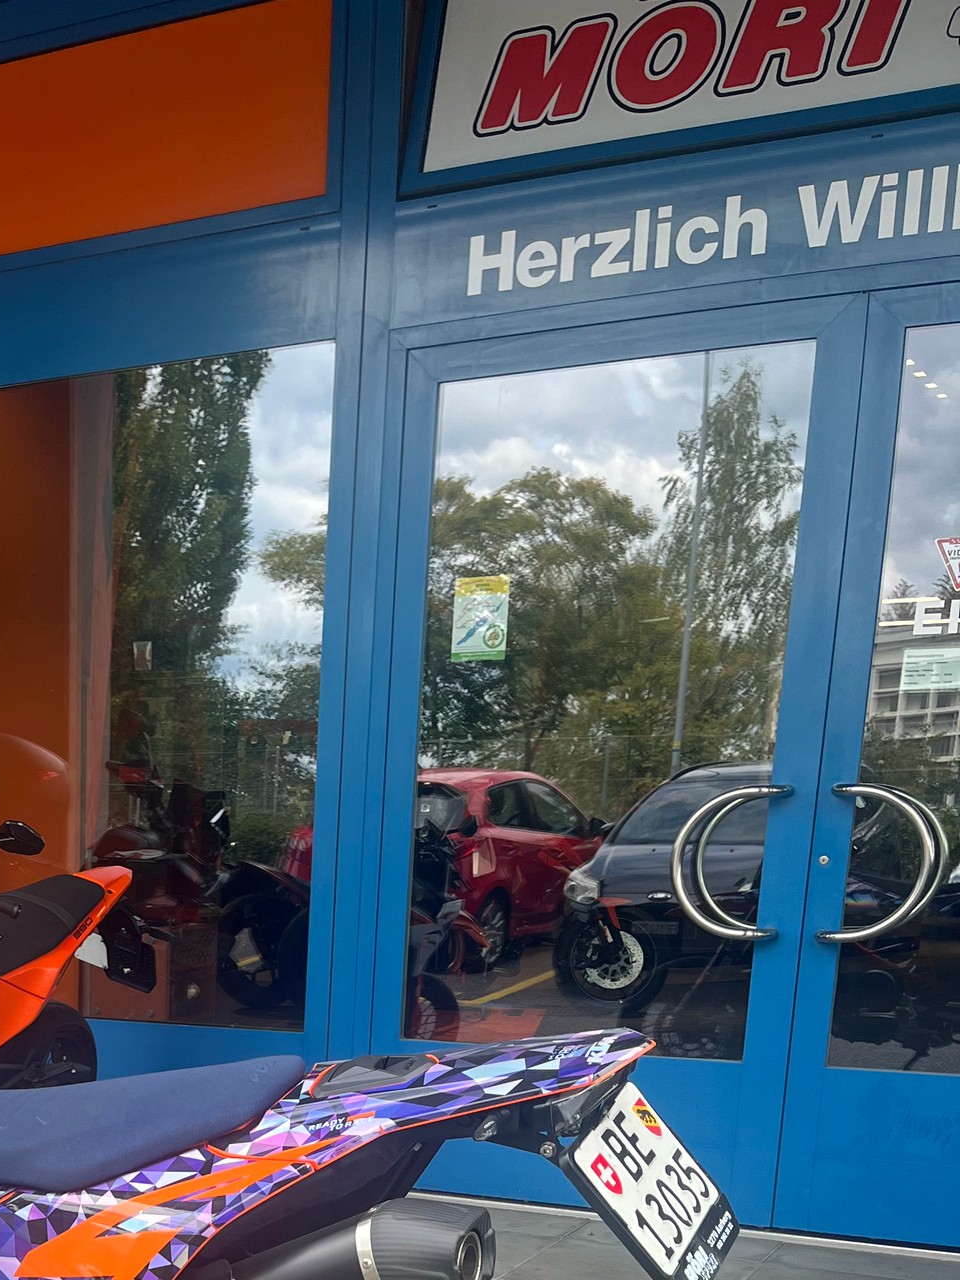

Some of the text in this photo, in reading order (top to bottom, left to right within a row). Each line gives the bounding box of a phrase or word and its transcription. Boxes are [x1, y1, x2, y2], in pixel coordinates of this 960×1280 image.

[466, 195, 769, 297] Herzlich
[308, 1116, 346, 1132] READY
[601, 1110, 656, 1183] BE
[634, 1148, 711, 1261] 13035
